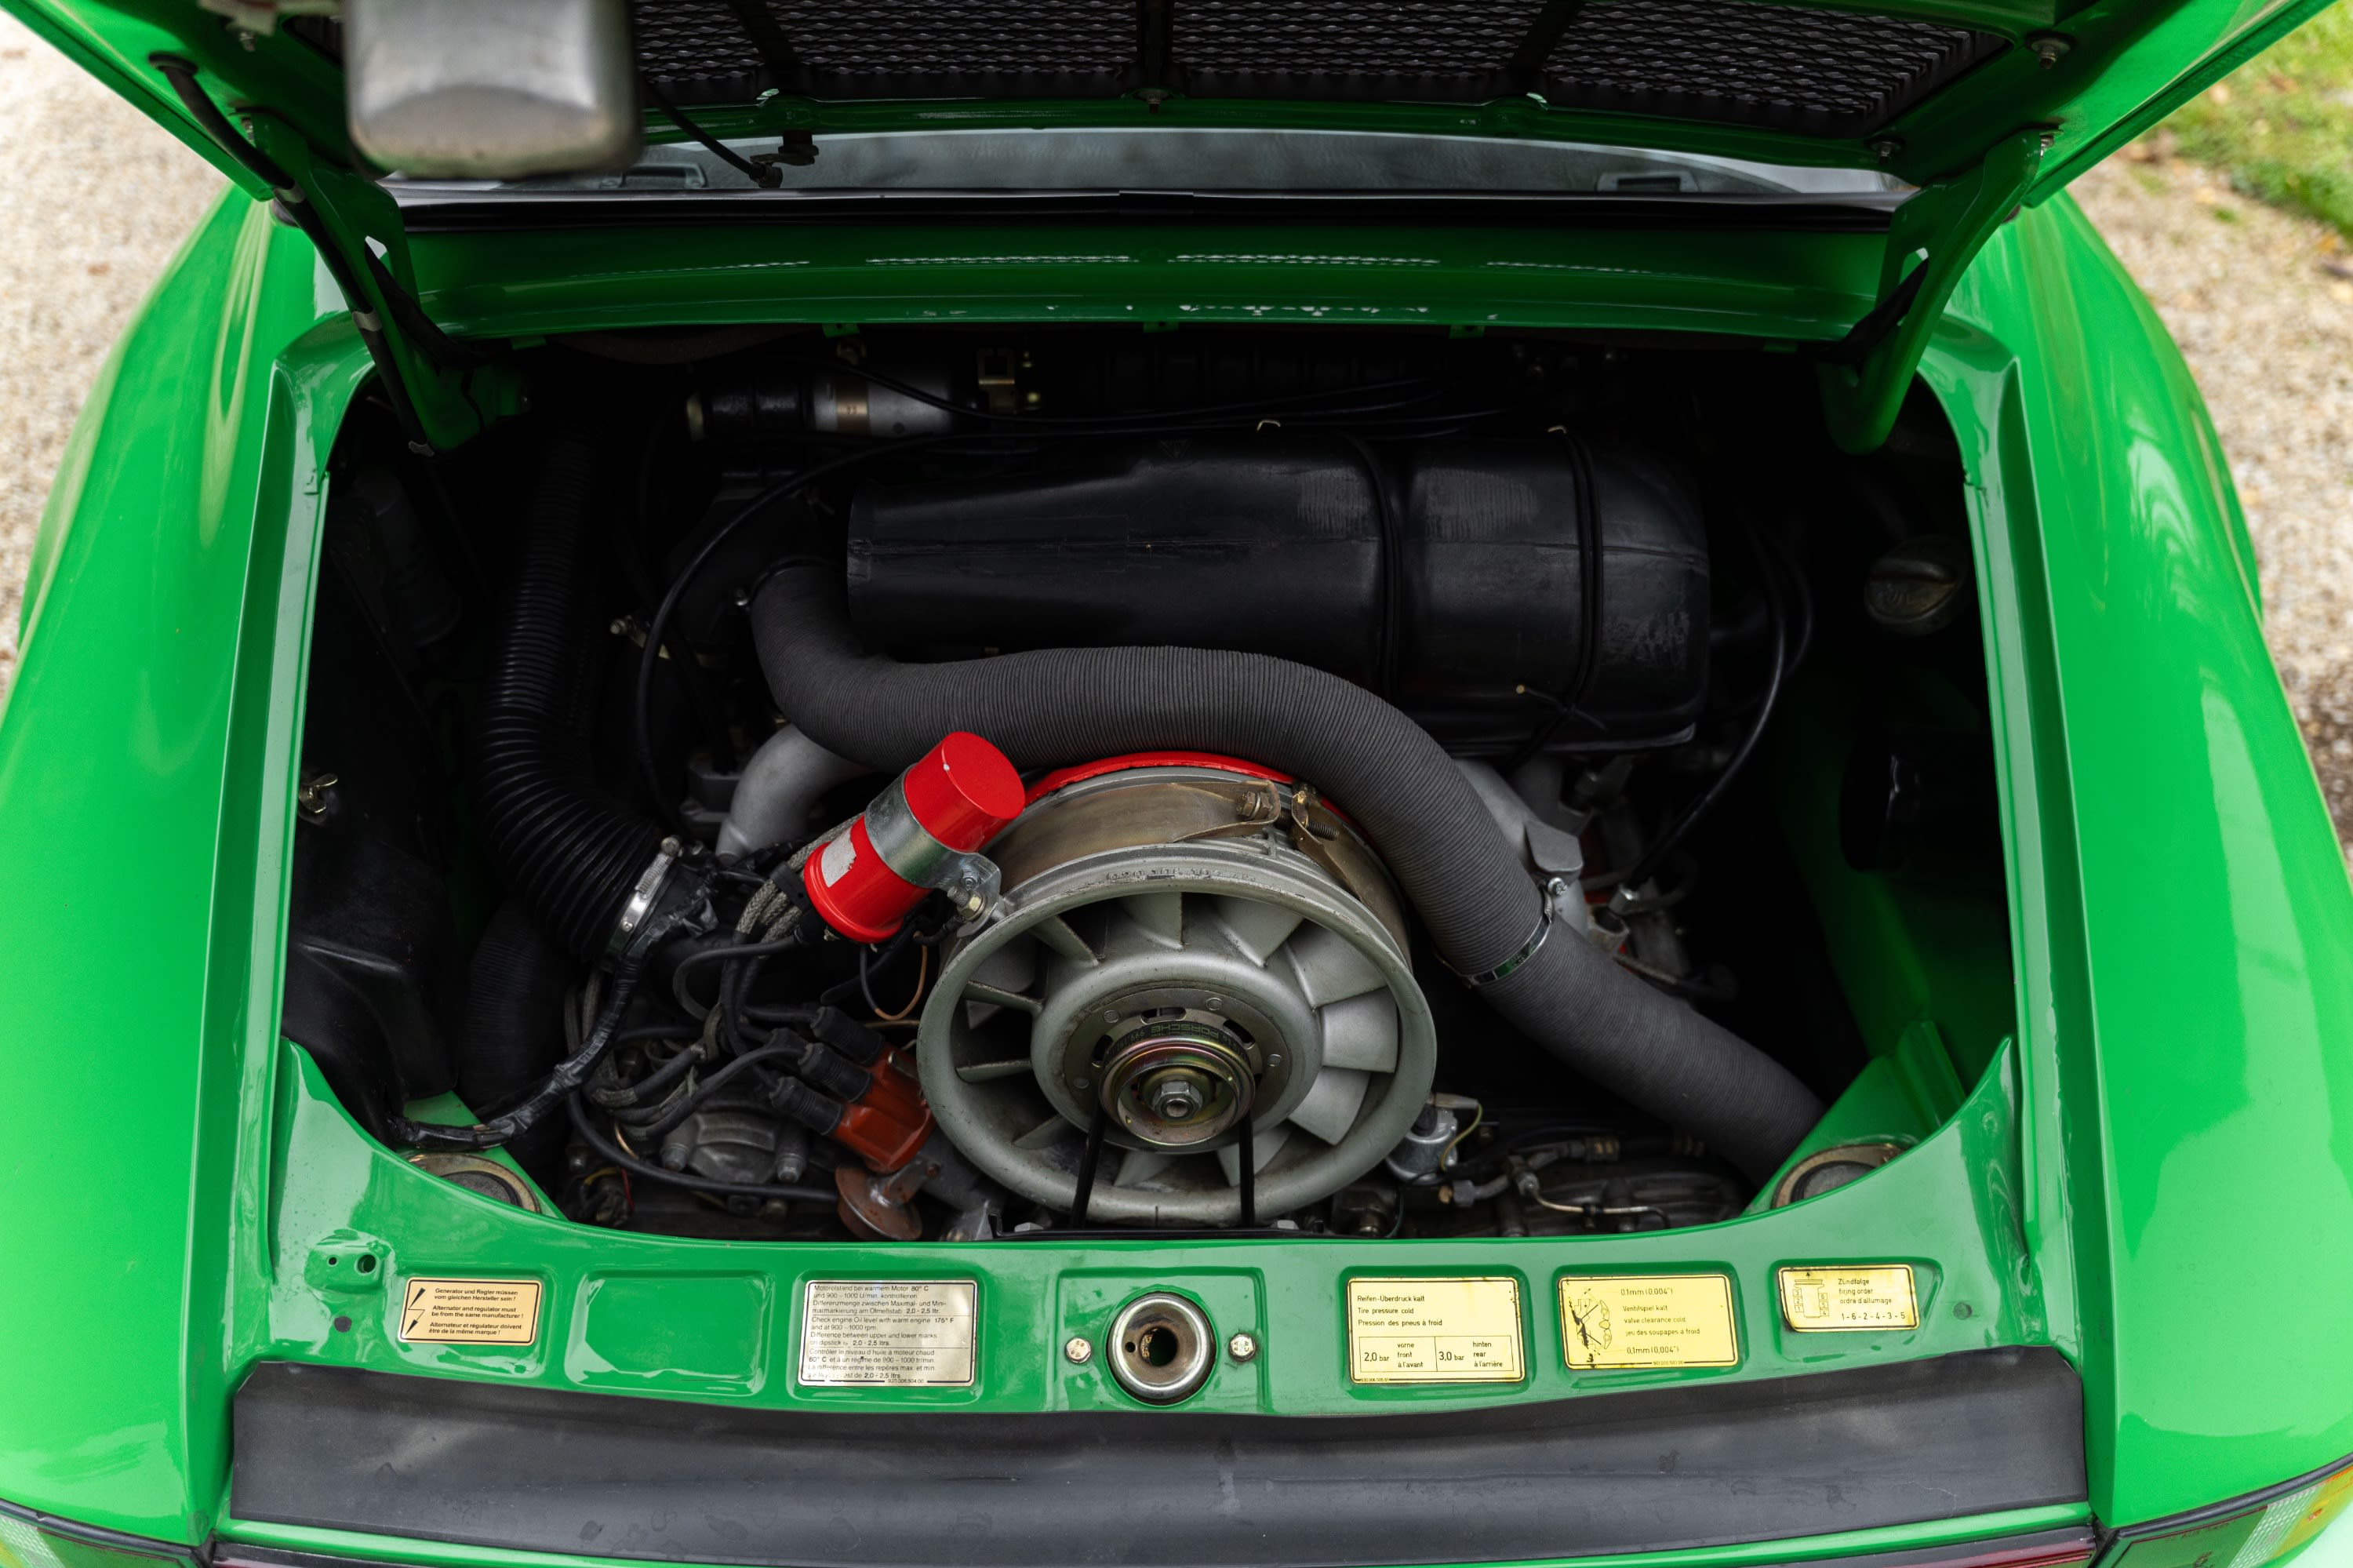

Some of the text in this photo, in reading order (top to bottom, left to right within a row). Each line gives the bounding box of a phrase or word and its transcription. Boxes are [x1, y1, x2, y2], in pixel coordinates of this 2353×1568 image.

[1151, 1023, 1219, 1039] PORSCHE
[1364, 1352, 1377, 1362] 2,0
[1438, 1351, 1452, 1361] 3,0
